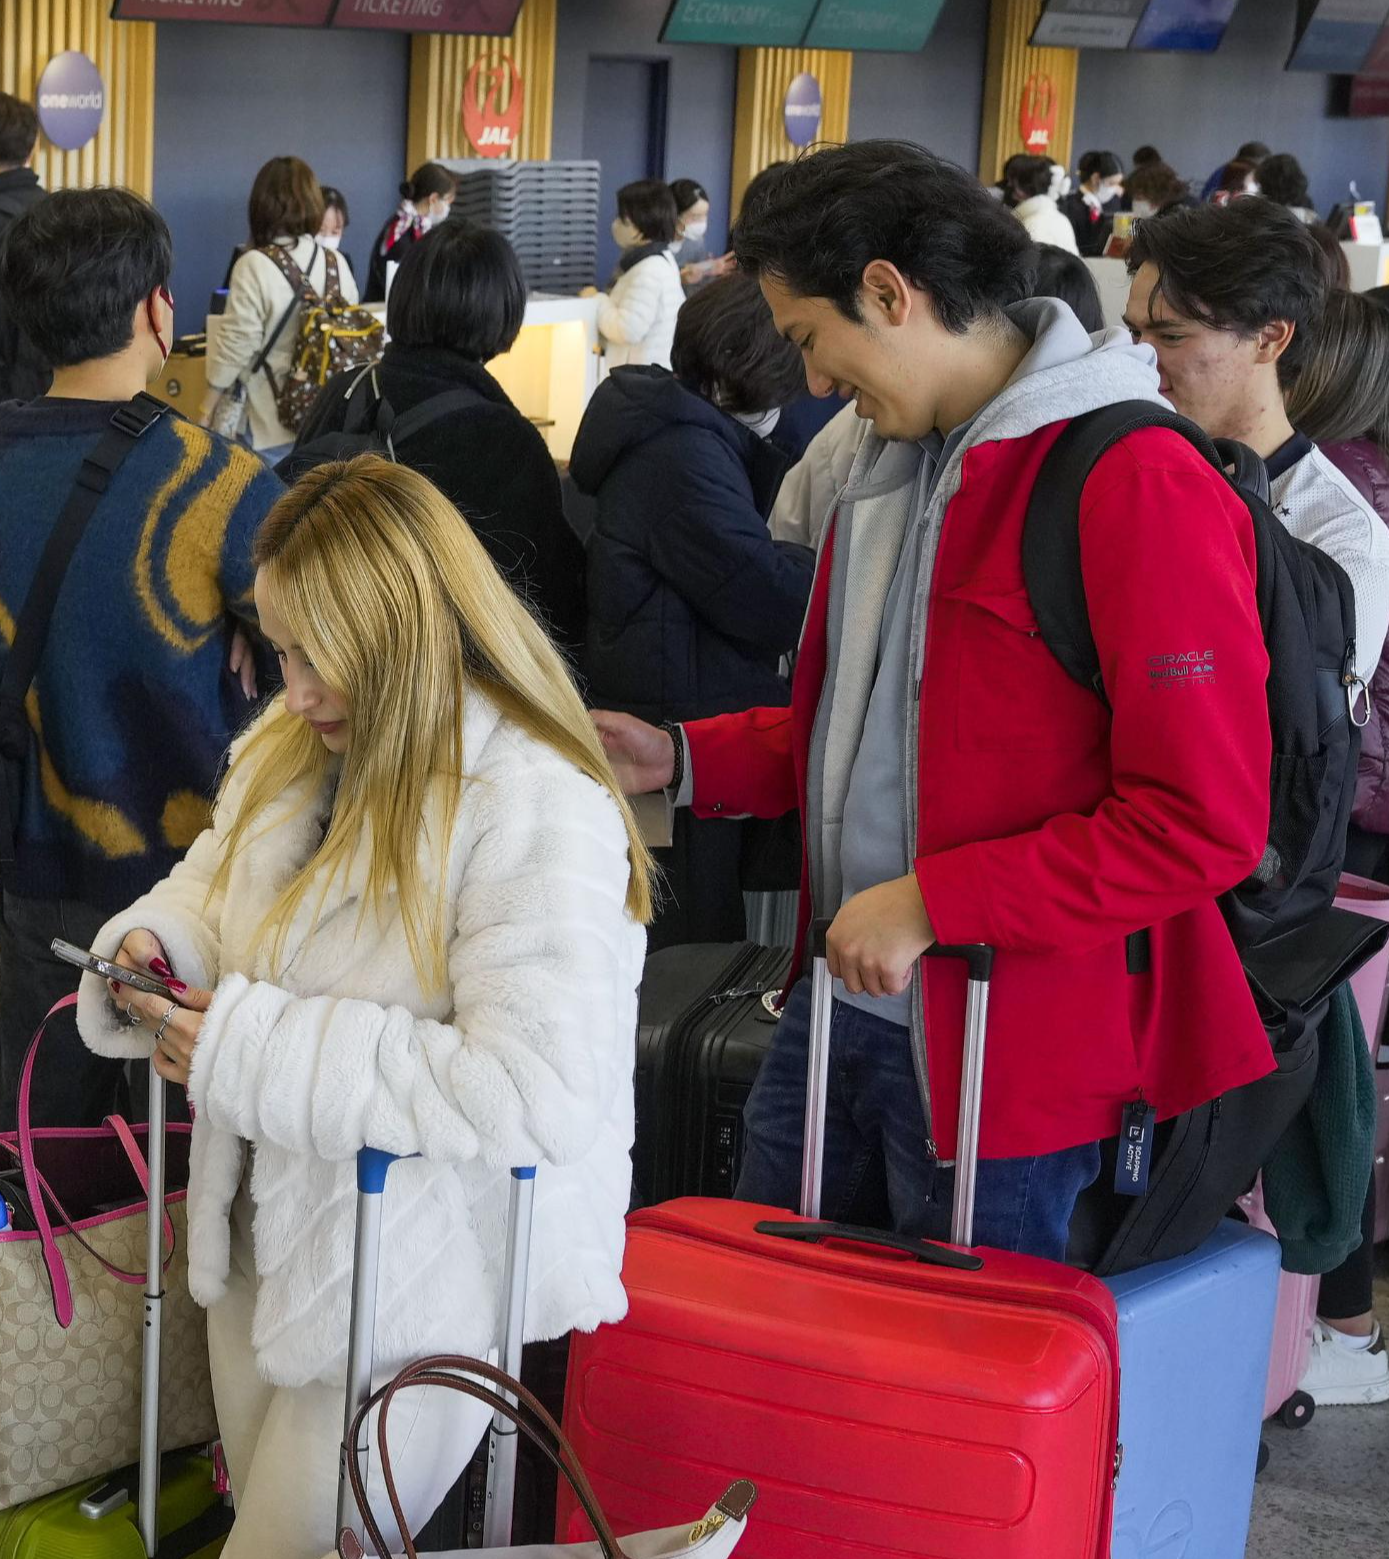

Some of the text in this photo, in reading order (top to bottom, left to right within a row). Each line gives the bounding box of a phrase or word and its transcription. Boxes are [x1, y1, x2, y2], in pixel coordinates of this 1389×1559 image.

[39, 91, 102, 109] oneworld
[477, 126, 512, 146] JAL
[1147, 650, 1214, 666] ORACLE
[1125, 1144, 1134, 1171] ACTIVE
[1132, 1145, 1143, 1182] SCAPPINO
